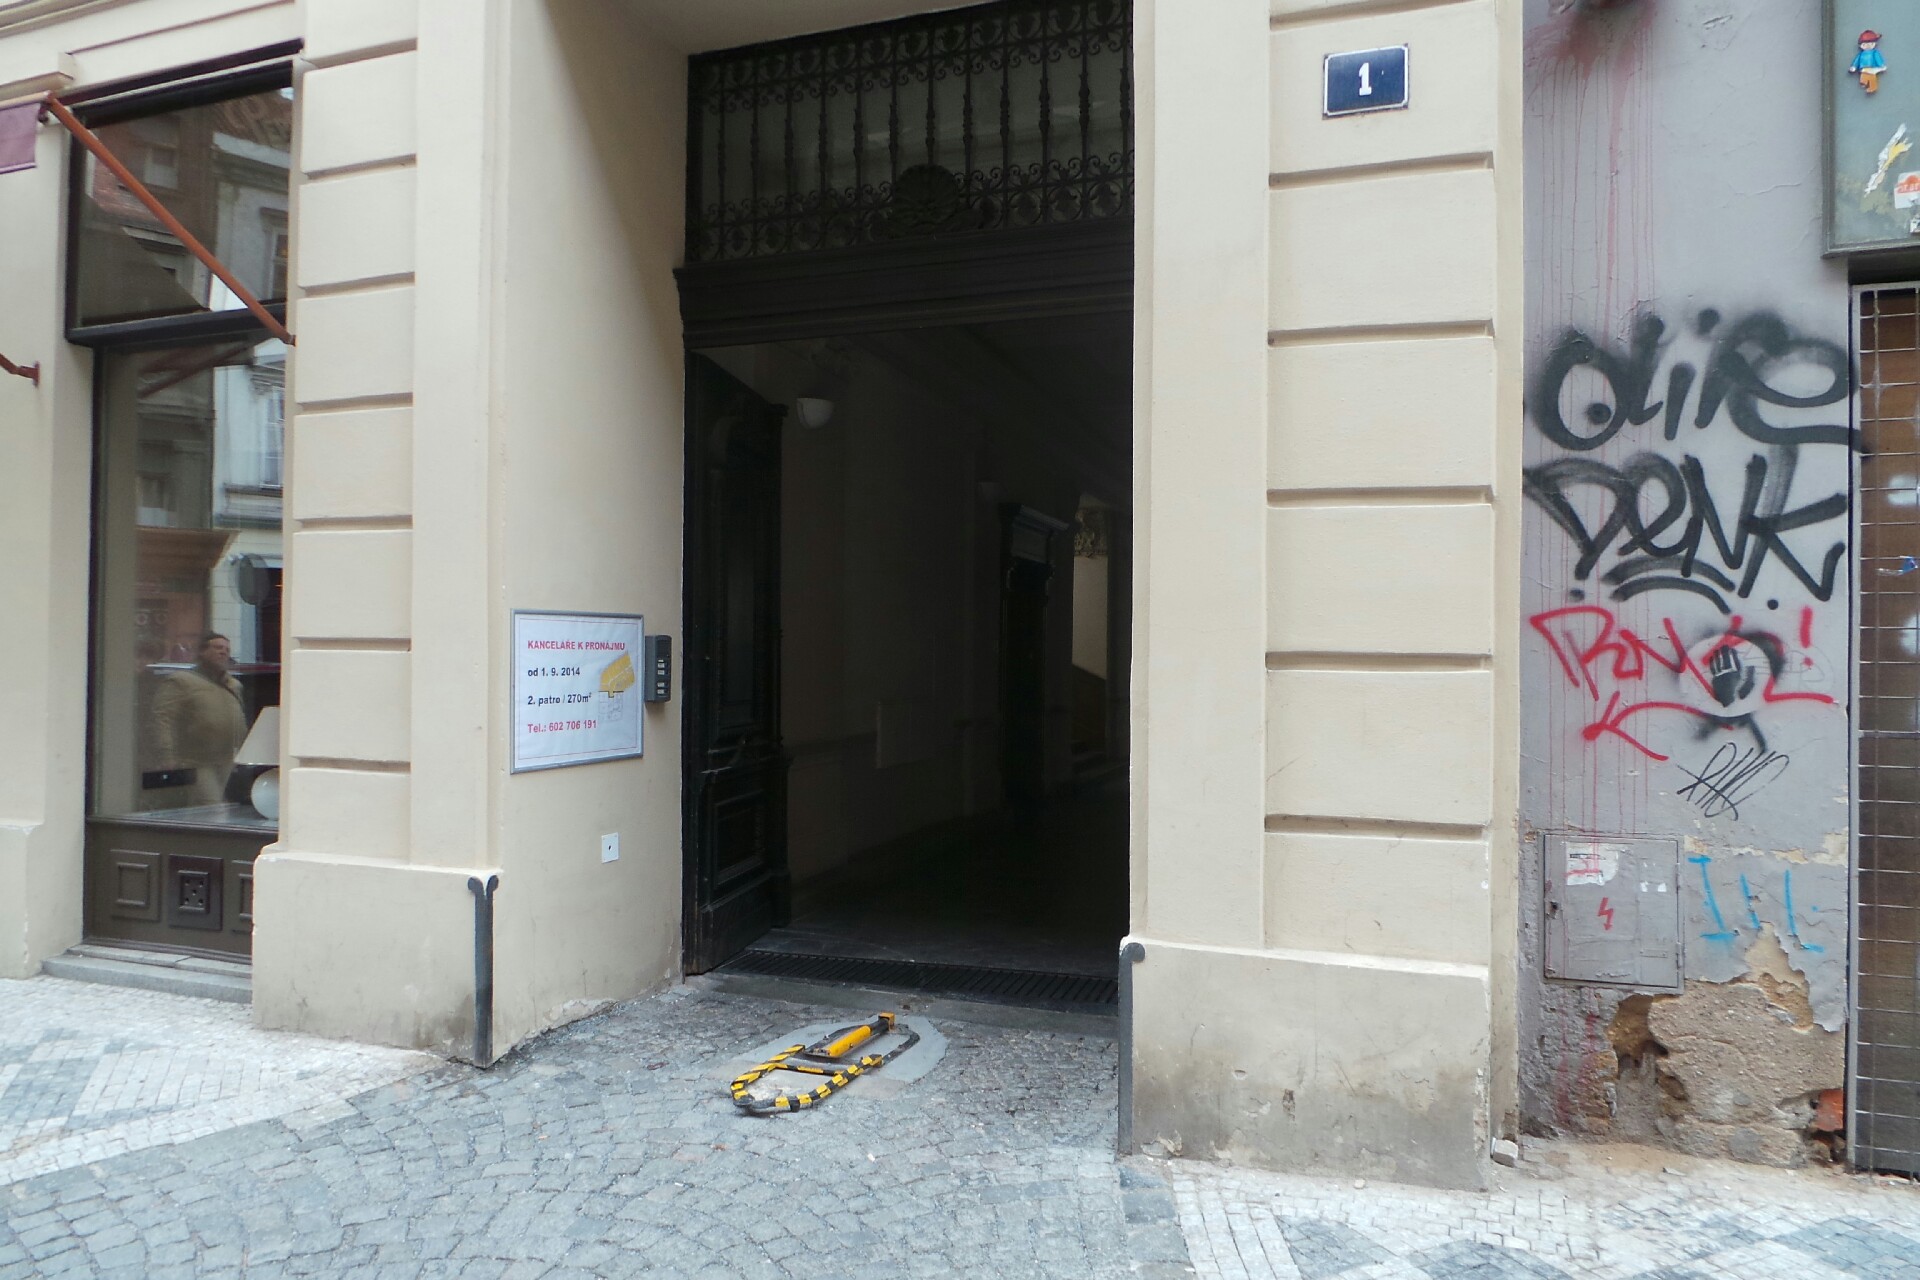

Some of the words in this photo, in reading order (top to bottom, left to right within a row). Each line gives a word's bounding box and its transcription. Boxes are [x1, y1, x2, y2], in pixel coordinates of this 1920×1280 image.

[1358, 62, 1372, 96] 1
[577, 642, 583, 650] K
[527, 667, 538, 676] od
[541, 667, 549, 676] 1.
[551, 667, 558, 676] 9.
[561, 667, 580, 676] 2014
[527, 695, 536, 705] 2.
[538, 696, 561, 707] patro
[548, 722, 564, 731] 602
[566, 720, 581, 730] 706
[583, 719, 597, 729] 191
